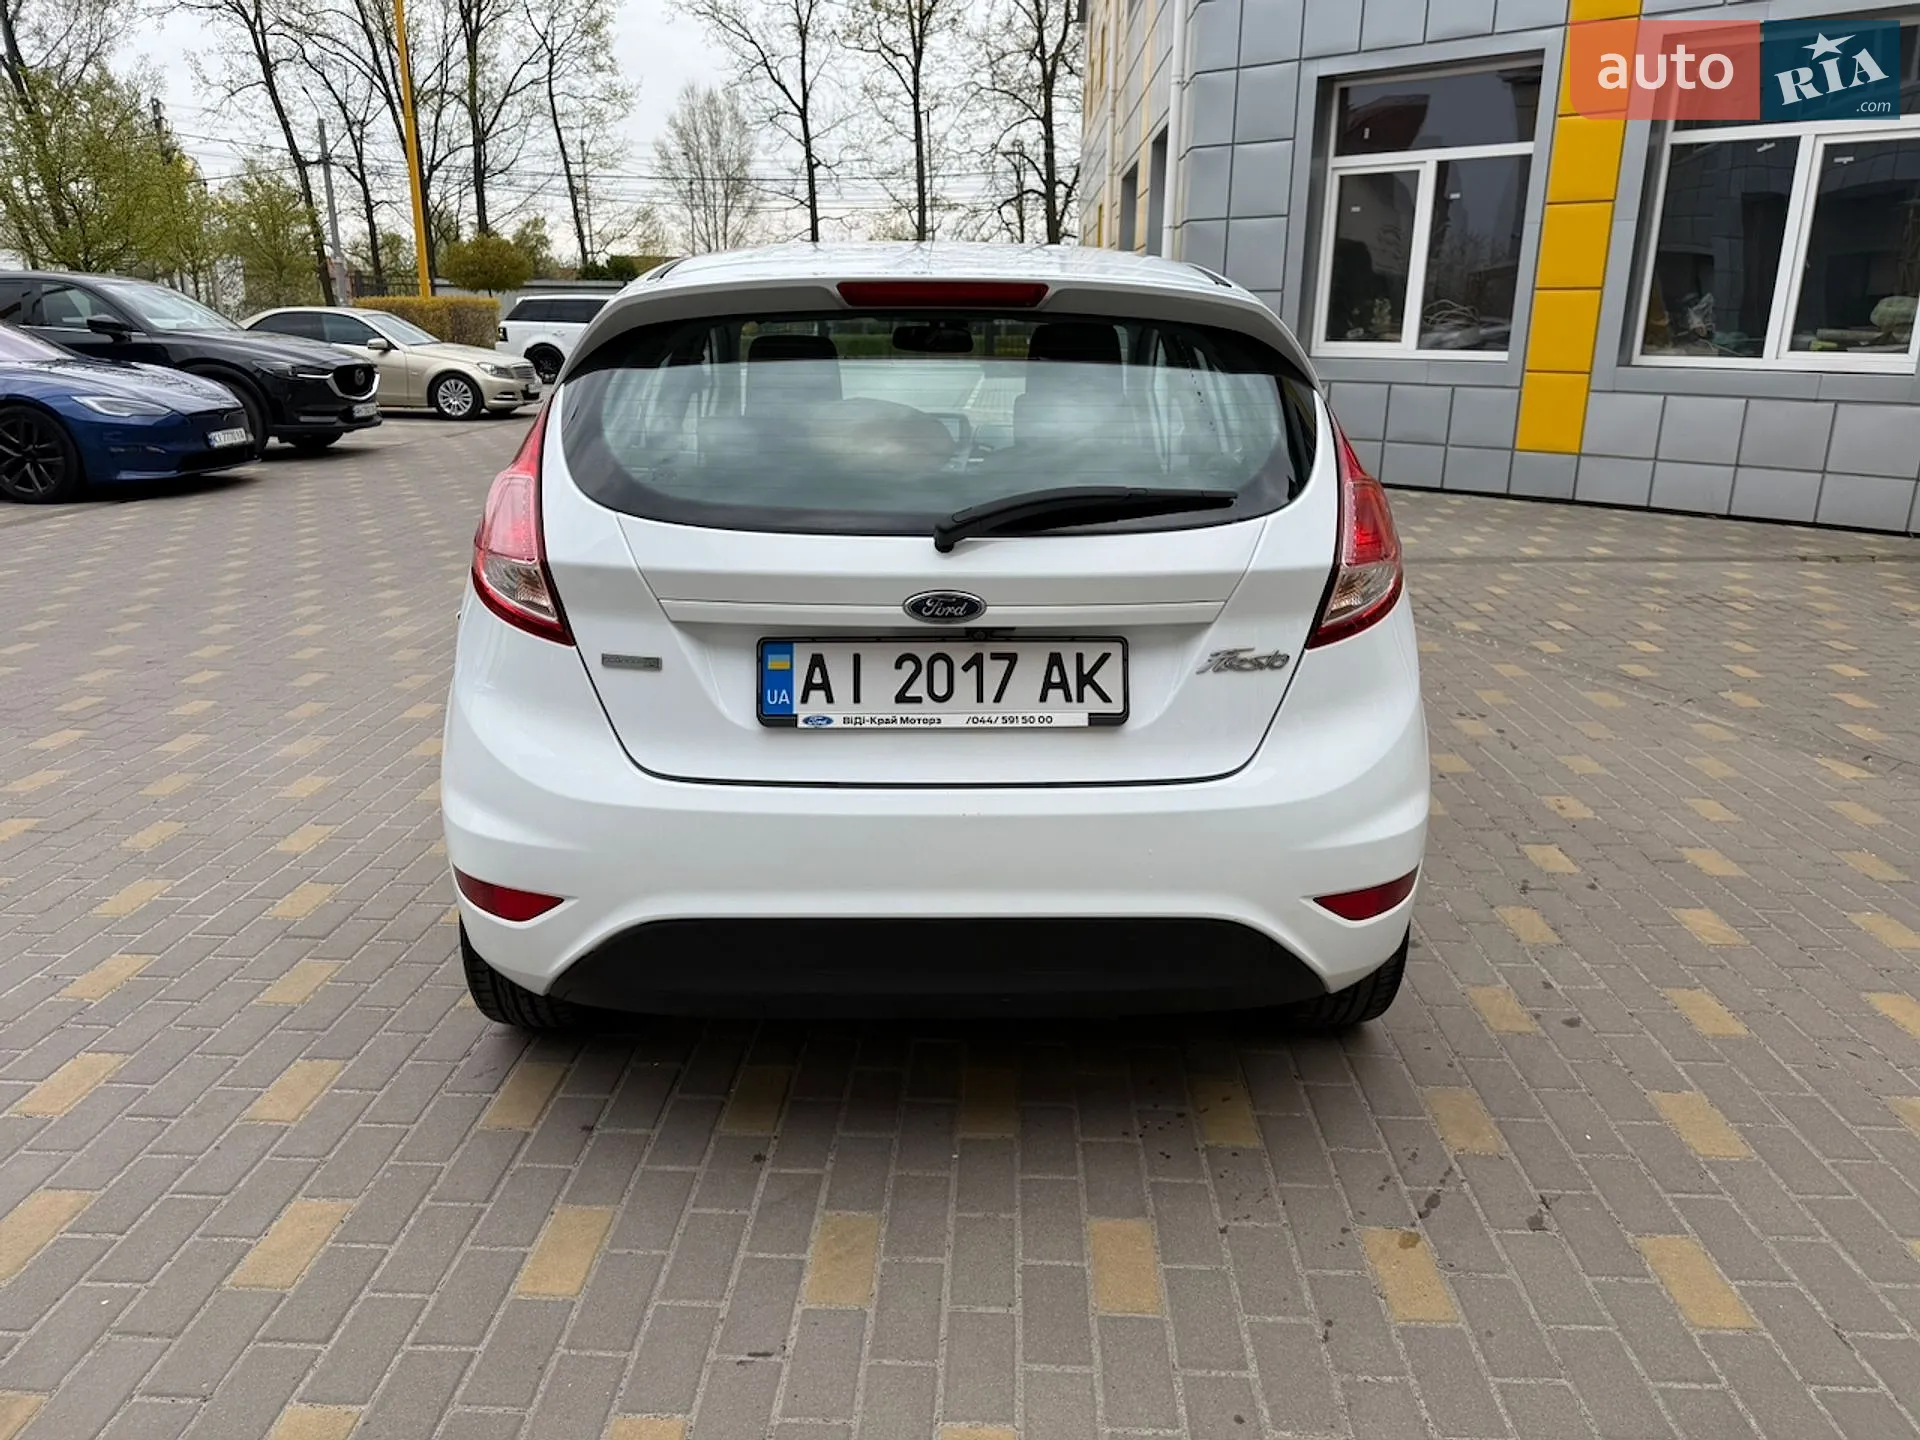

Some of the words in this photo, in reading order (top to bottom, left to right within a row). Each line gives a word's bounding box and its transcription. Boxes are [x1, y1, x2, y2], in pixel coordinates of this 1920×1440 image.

[1196, 647, 1290, 675] Fiesta
[800, 652, 861, 704] AI
[894, 652, 1018, 704] 2017
[1039, 652, 1113, 704] AK
[767, 690, 790, 705] UA
[1001, 715, 1019, 725] 591
[1038, 715, 1053, 725] 00
